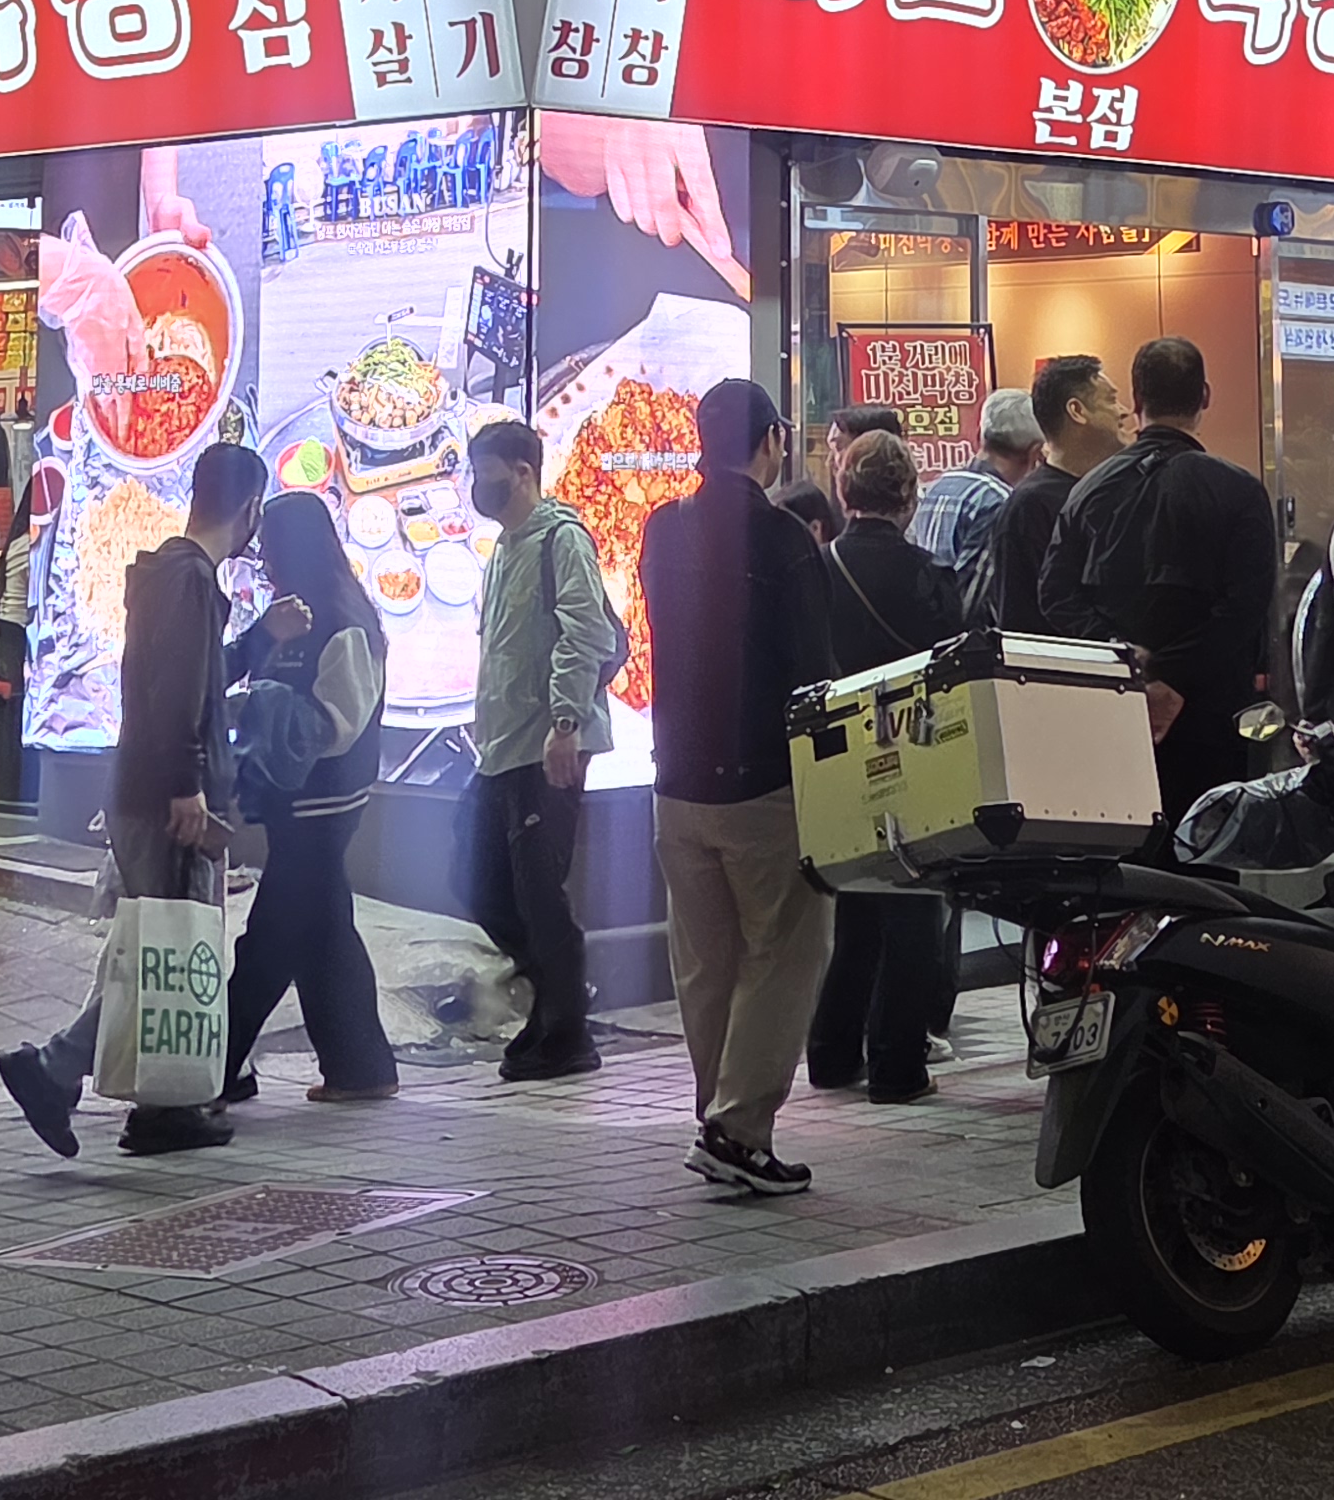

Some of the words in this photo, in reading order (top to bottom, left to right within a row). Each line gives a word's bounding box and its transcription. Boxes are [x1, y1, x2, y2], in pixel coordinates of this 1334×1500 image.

[1032, 77, 1139, 152] 본점
[867, 341, 900, 368] 1분
[905, 341, 970, 368] 거리에
[861, 369, 979, 405] 미친막창
[1199, 932, 1272, 953] NMAX
[141, 946, 186, 994] RE:
[140, 1008, 223, 1058] EARTH
[1050, 1022, 1100, 1050] 703
